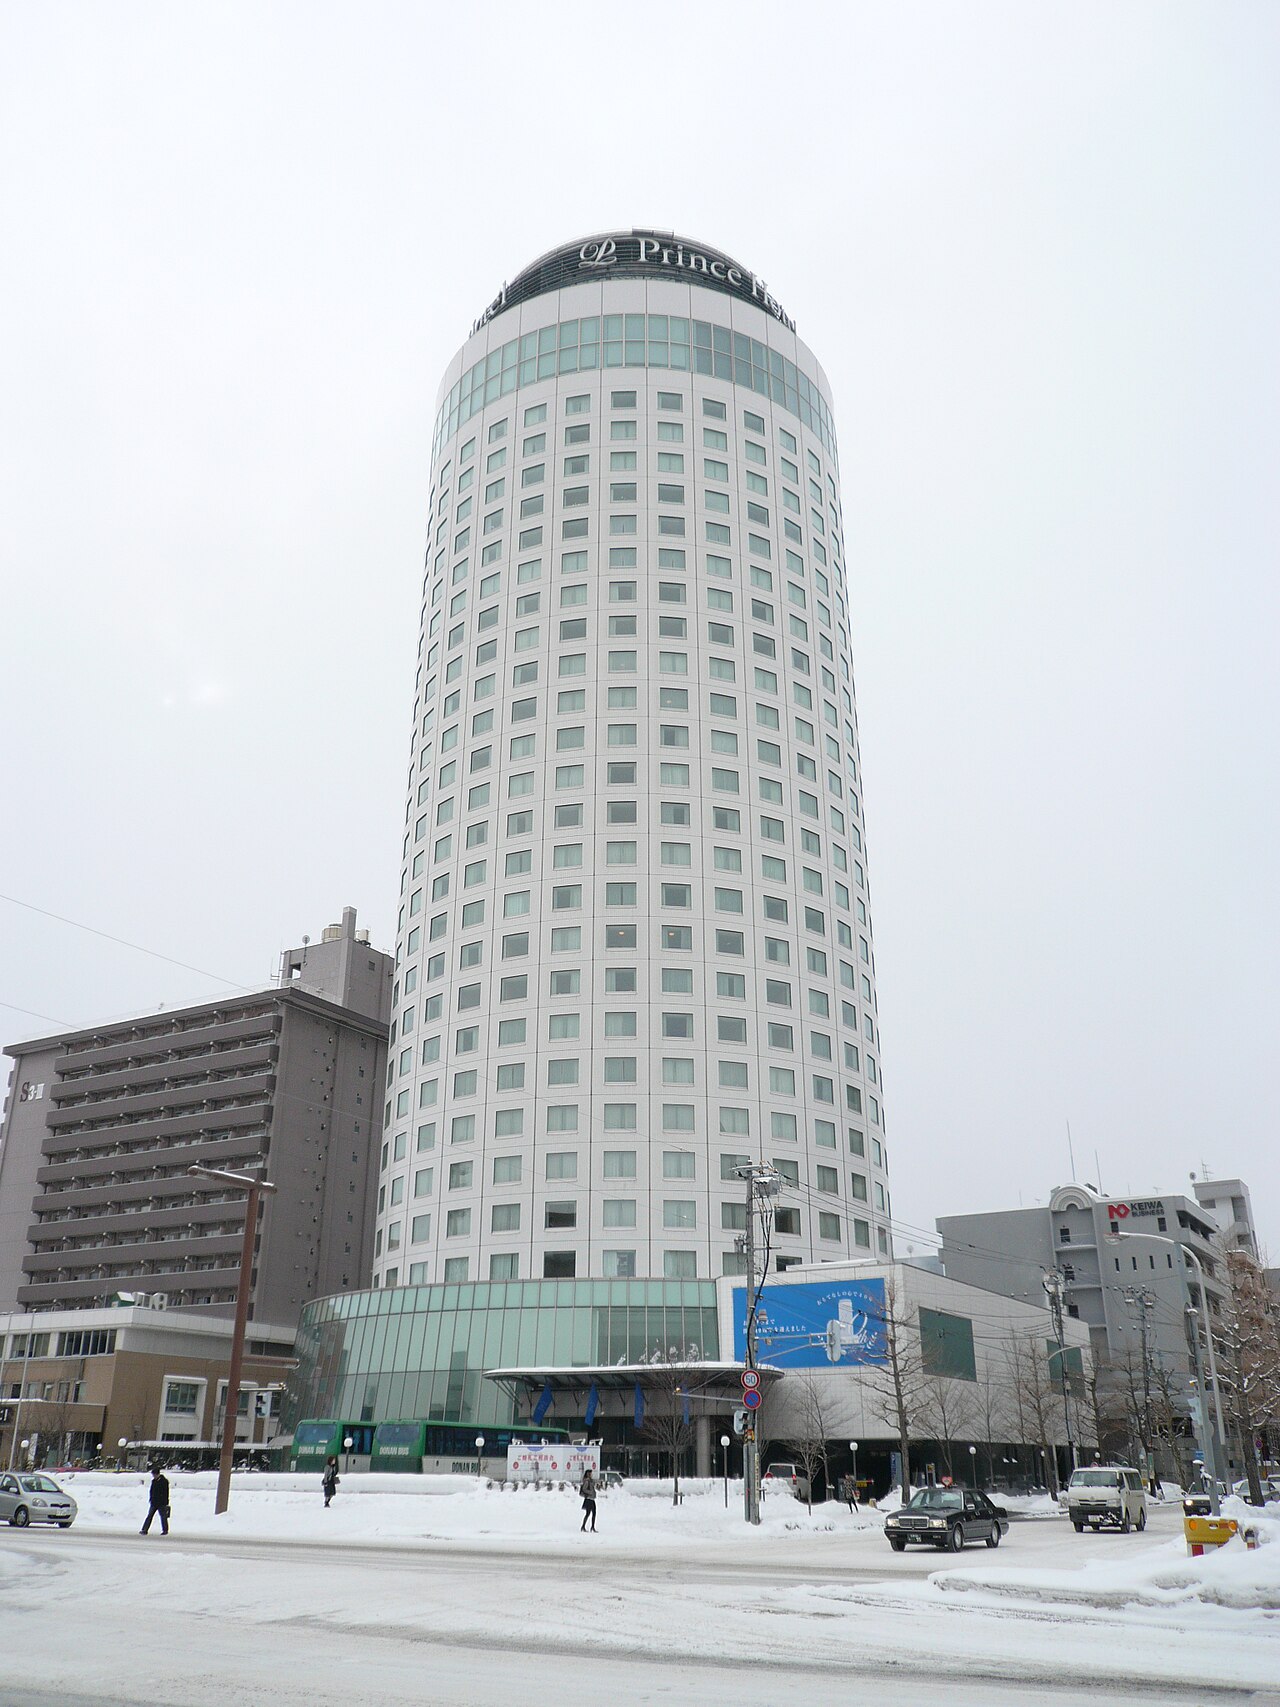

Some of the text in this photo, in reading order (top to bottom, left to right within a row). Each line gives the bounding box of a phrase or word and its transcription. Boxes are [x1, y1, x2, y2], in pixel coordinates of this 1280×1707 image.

[636, 237, 742, 286] Prince
[1130, 1201, 1163, 1211] KEIWA
[1131, 1209, 1164, 1217] BUSINESS
[745, 1375, 756, 1384] 50
[397, 1447, 409, 1455] BUS
[452, 1461, 470, 1473] DONAN
